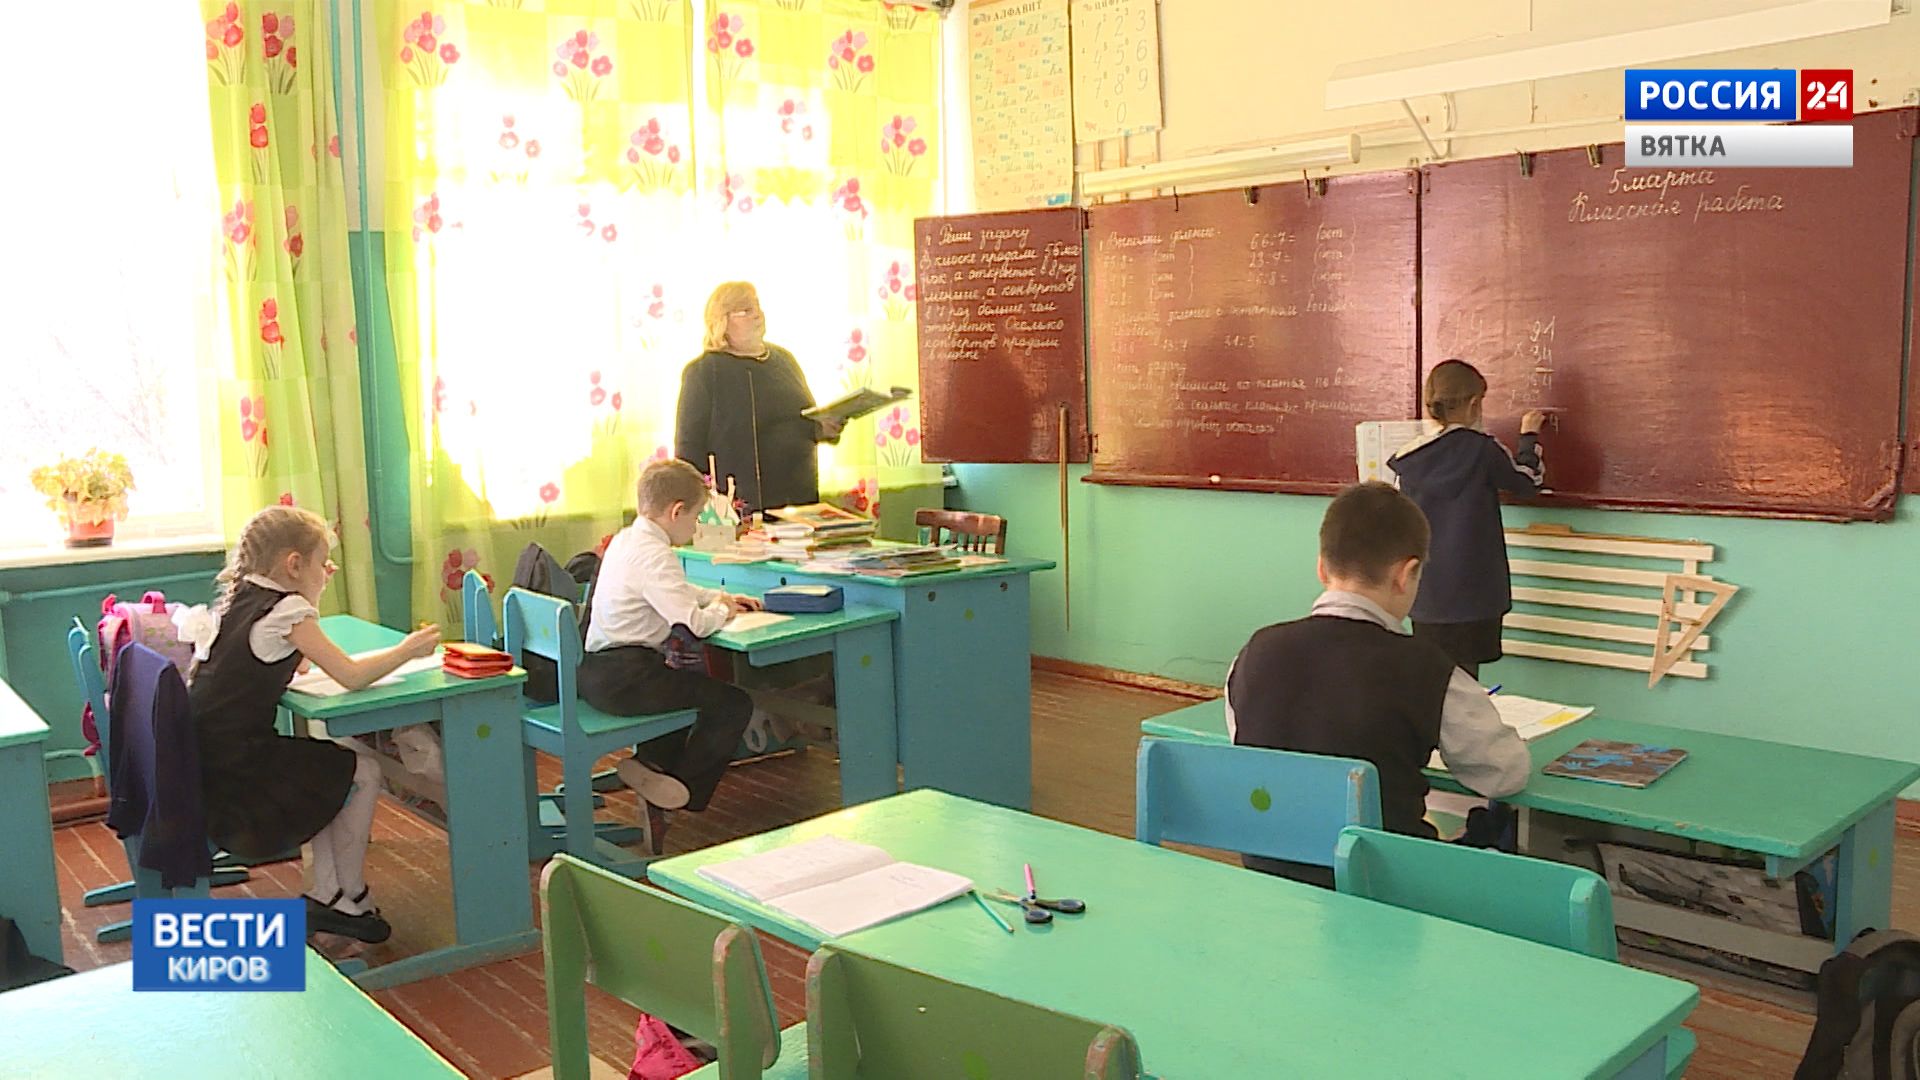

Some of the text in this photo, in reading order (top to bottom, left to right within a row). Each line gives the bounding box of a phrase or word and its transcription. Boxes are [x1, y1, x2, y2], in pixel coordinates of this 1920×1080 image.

[1114, 15, 1124, 37] 2
[1136, 9, 1146, 31] 3
[1114, 43, 1125, 66] 5
[1136, 39, 1148, 62] 6
[1114, 73, 1124, 95] 8
[1137, 68, 1148, 90] 9
[1117, 102, 1127, 123] 0
[1694, 185, 1785, 224] работа
[980, 229, 1030, 250] задачу
[980, 249, 1039, 271] продали
[987, 287, 997, 296] а
[1530, 315, 1556, 342] 91
